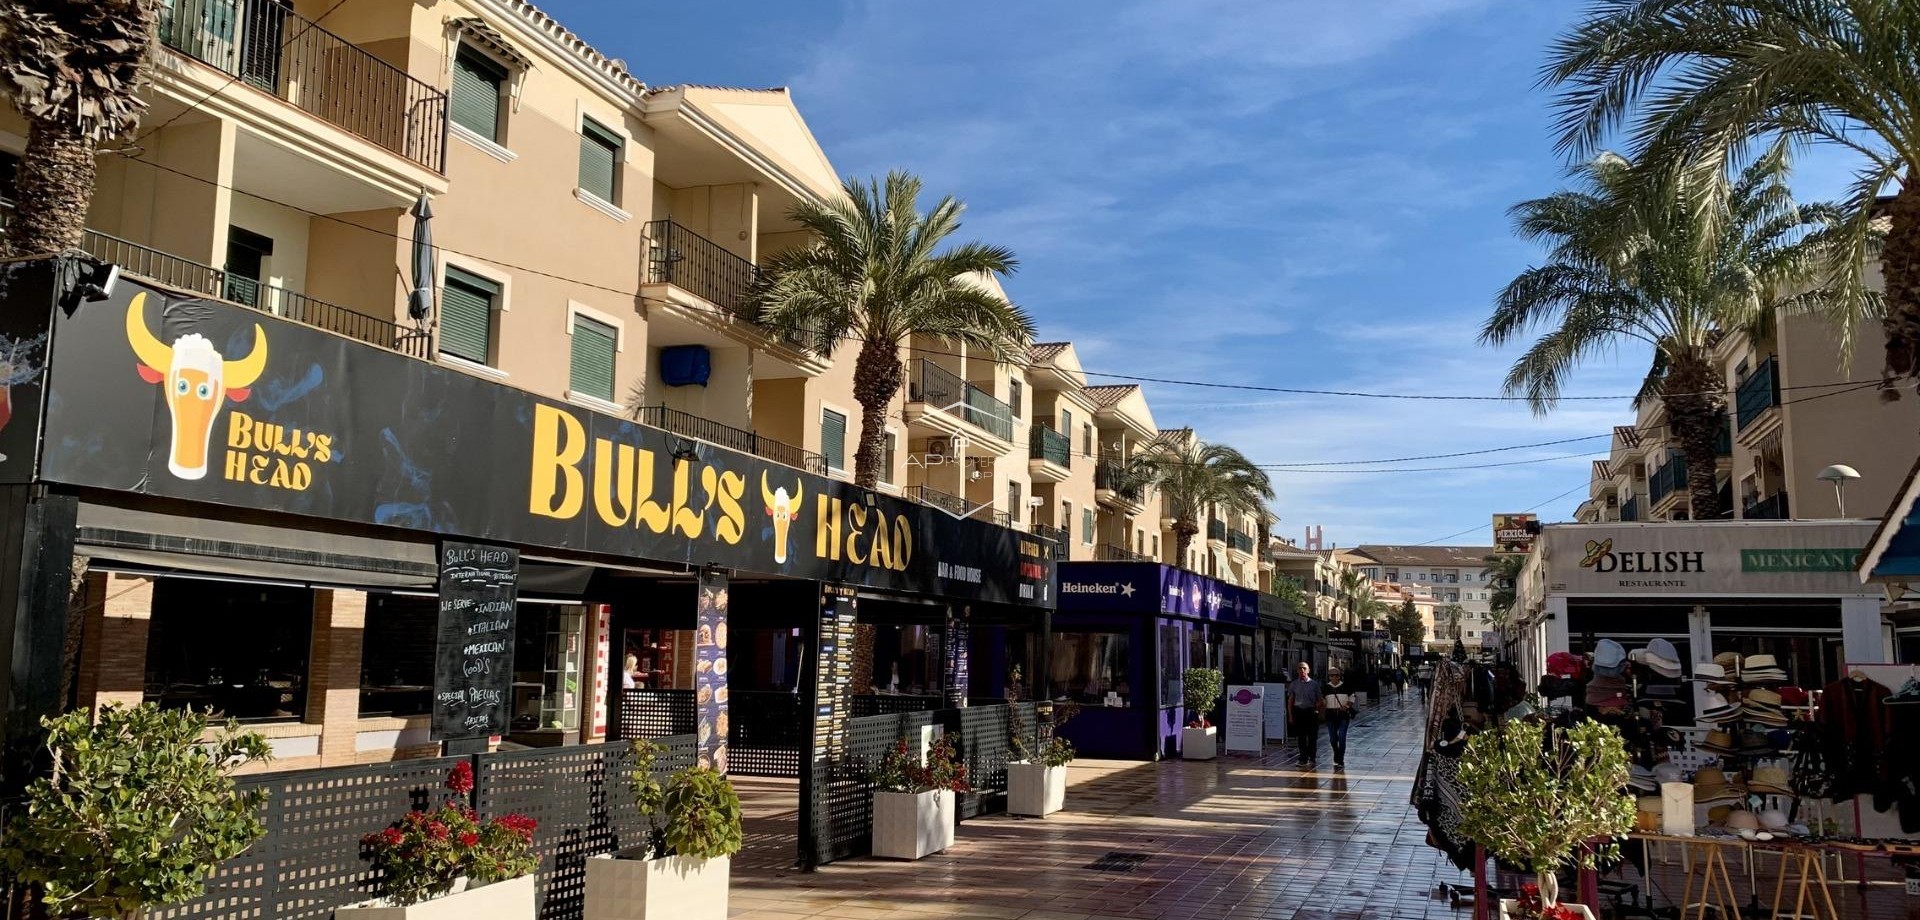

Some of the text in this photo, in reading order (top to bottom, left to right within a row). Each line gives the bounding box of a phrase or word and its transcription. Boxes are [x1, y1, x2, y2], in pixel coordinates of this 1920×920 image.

[228, 411, 332, 463] BULL'S
[225, 450, 312, 491] HEAD
[529, 402, 913, 572] BULL'S HEAD
[480, 550, 509, 563] HEAD
[1594, 551, 1706, 573] DELISH
[1748, 554, 1845, 567] MEXICAN
[954, 564, 966, 581] FOOD
[966, 567, 982, 584] HOUSE
[1062, 582, 1117, 594] Heineken
[1619, 579, 1687, 588] RESTAURANTE
[441, 600, 452, 612] WE
